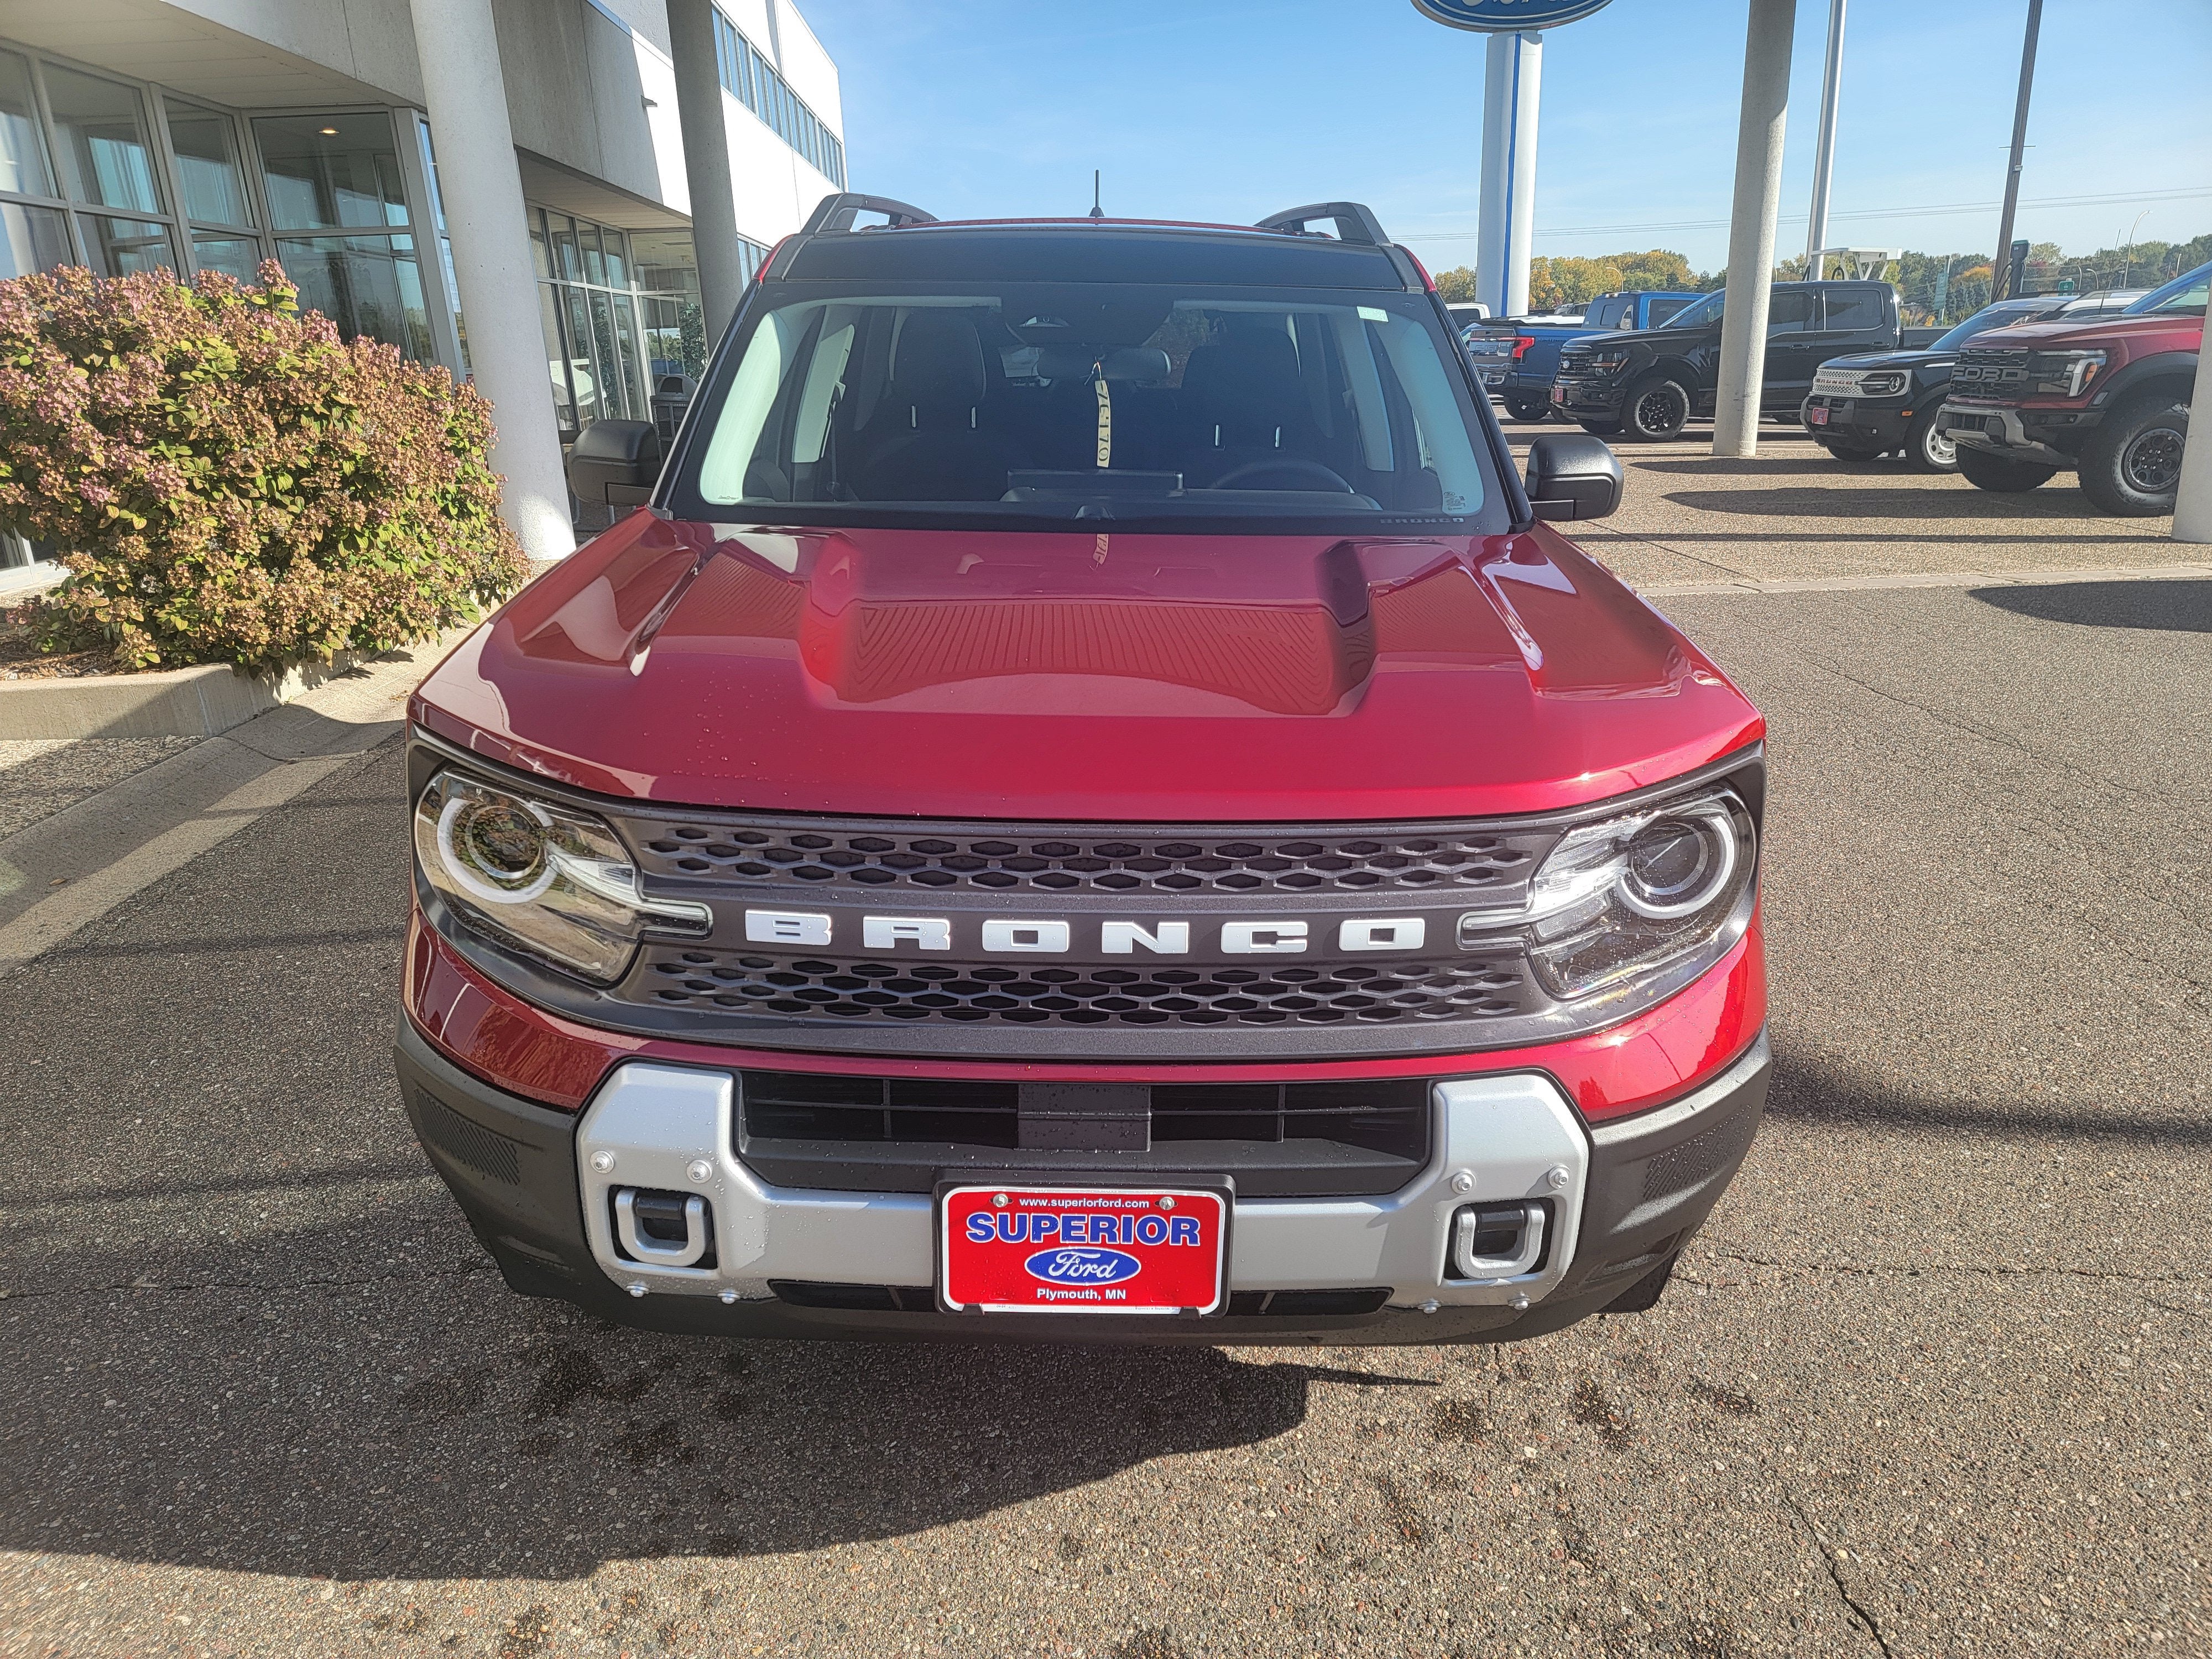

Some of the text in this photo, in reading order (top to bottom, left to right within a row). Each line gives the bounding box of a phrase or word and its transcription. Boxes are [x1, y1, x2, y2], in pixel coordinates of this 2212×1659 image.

[1951, 366, 2029, 382] FORD
[745, 910, 1425, 953] BRONCO
[1019, 1198, 1150, 1209] www.superiorford.com
[966, 1212, 1200, 1246] SUPERIOR
[1048, 1251, 1119, 1279] Ford
[1037, 1288, 1126, 1301] Plymouth, MN
